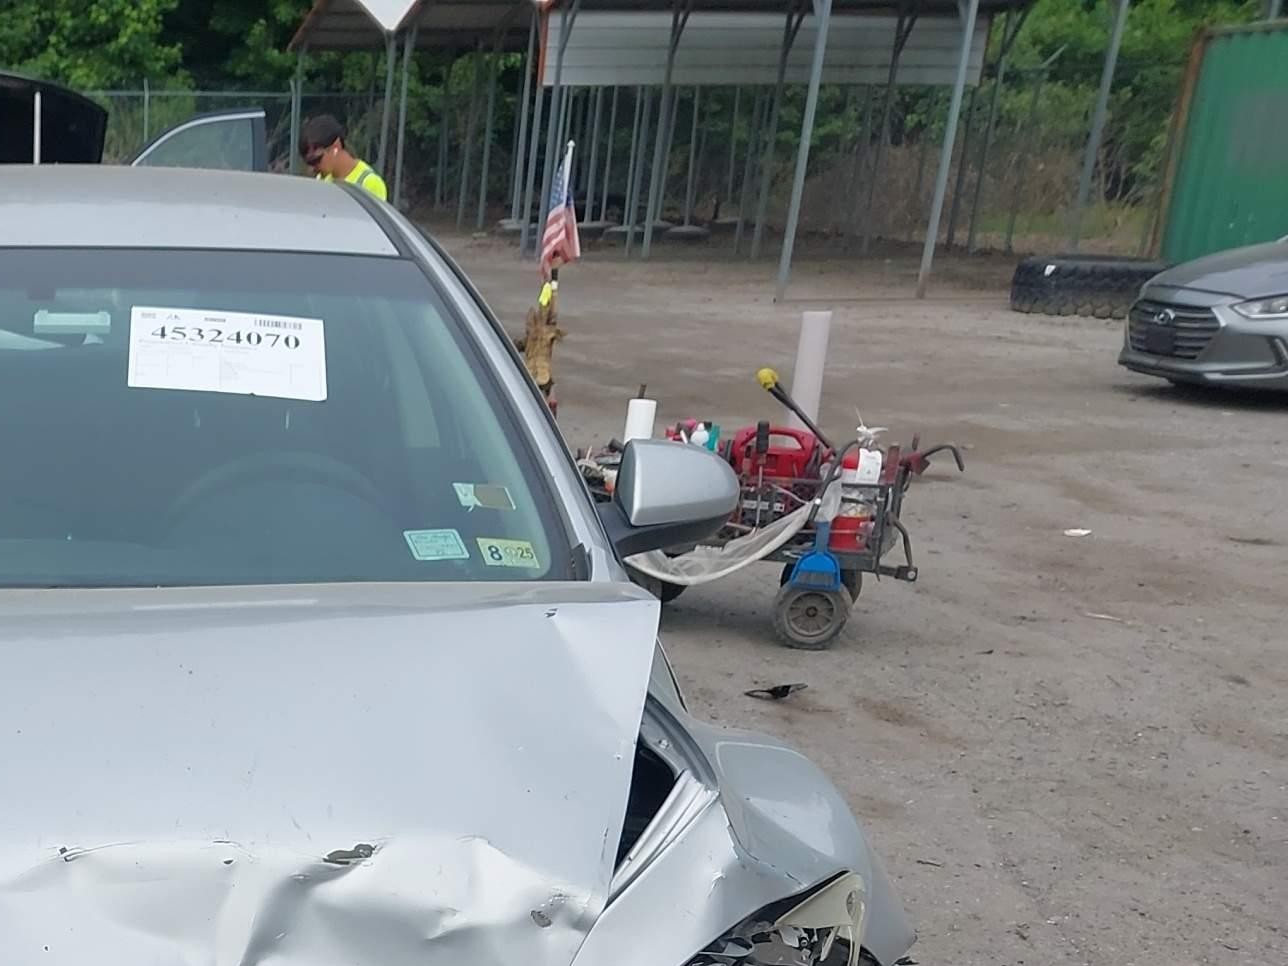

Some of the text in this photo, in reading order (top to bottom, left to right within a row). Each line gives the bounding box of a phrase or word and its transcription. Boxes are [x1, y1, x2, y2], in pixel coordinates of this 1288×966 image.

[151, 325, 301, 349] 45324070
[487, 545, 534, 561] 8 25
